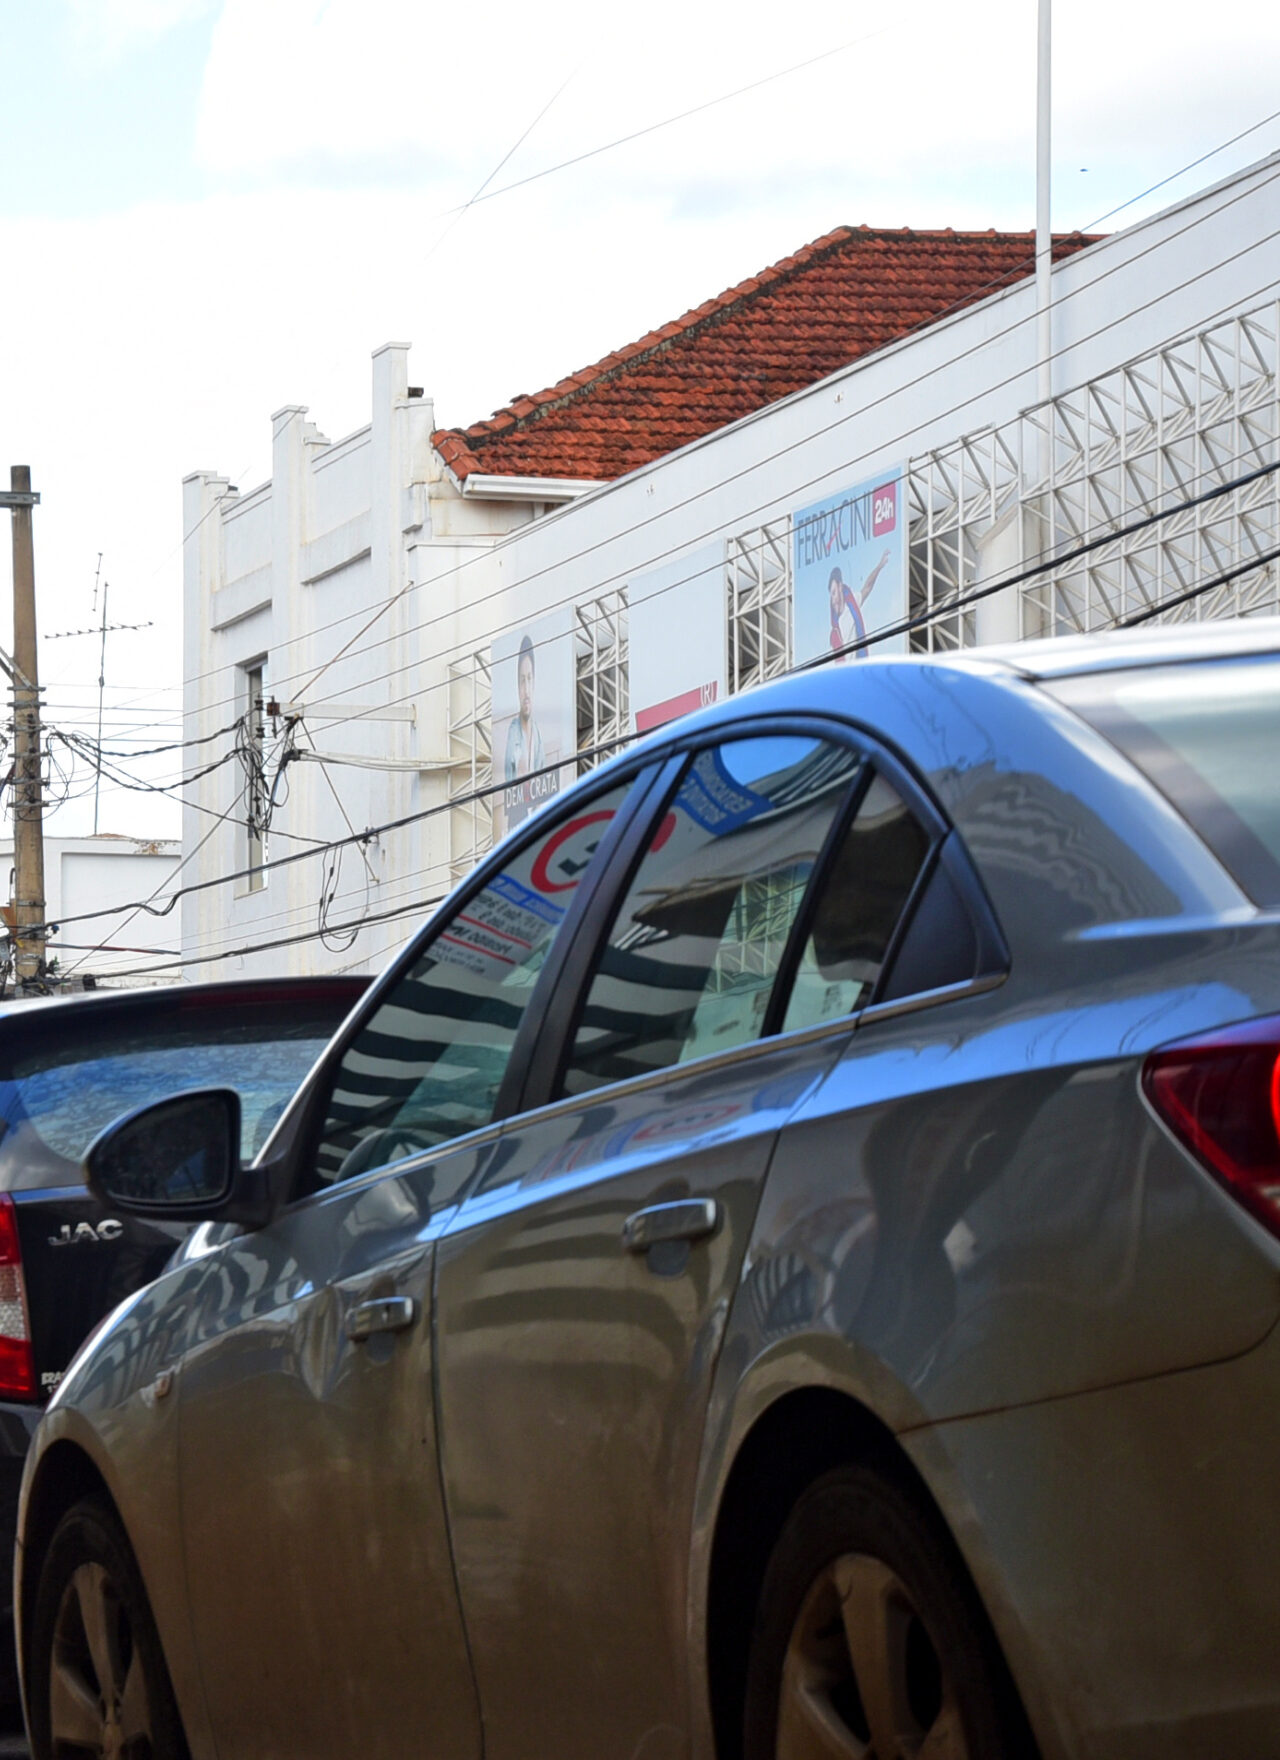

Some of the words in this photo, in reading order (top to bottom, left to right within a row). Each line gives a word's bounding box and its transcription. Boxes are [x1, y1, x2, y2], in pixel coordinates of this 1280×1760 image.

[797, 490, 871, 569] FERRACINI
[874, 497, 894, 525] 24h
[47, 1219, 124, 1246] JAC
